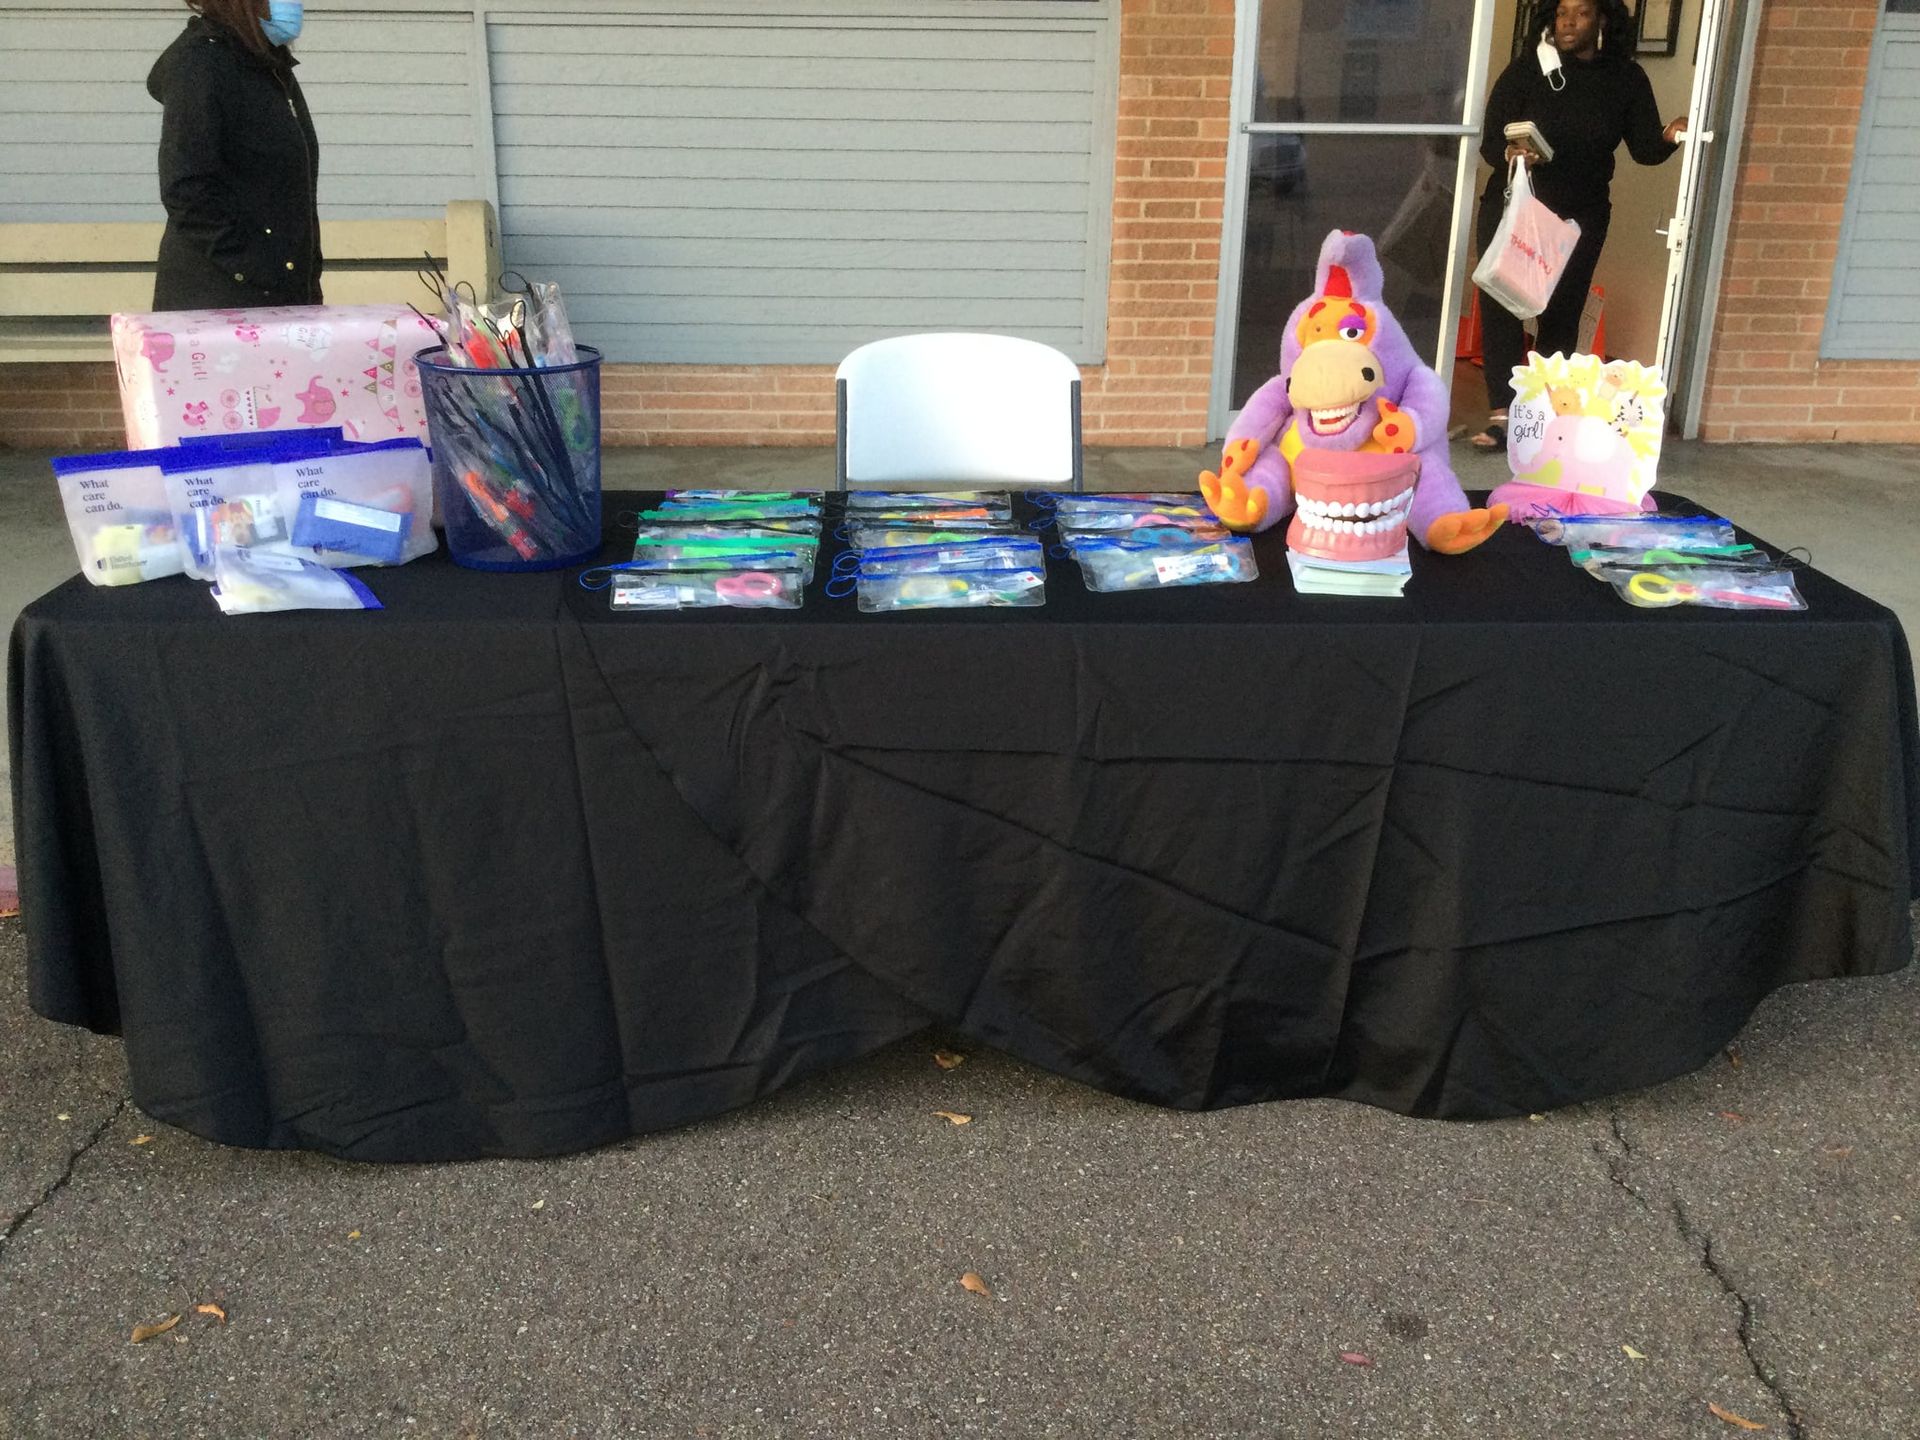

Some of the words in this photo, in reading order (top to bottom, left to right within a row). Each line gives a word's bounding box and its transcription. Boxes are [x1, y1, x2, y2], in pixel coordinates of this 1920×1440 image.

[1514, 405, 1533, 420] It's
[1538, 410, 1545, 421] a
[1513, 421, 1544, 443] girl!
[295, 466, 324, 477] What
[79, 479, 110, 489] What
[184, 477, 214, 486] What
[297, 480, 320, 489] care
[82, 492, 106, 502] care
[187, 488, 210, 497] care
[300, 490, 320, 500] can
[320, 487, 337, 497] do.
[85, 504, 105, 514] can
[106, 500, 124, 511] do.
[189, 499, 210, 509] can
[210, 495, 227, 506] do.
